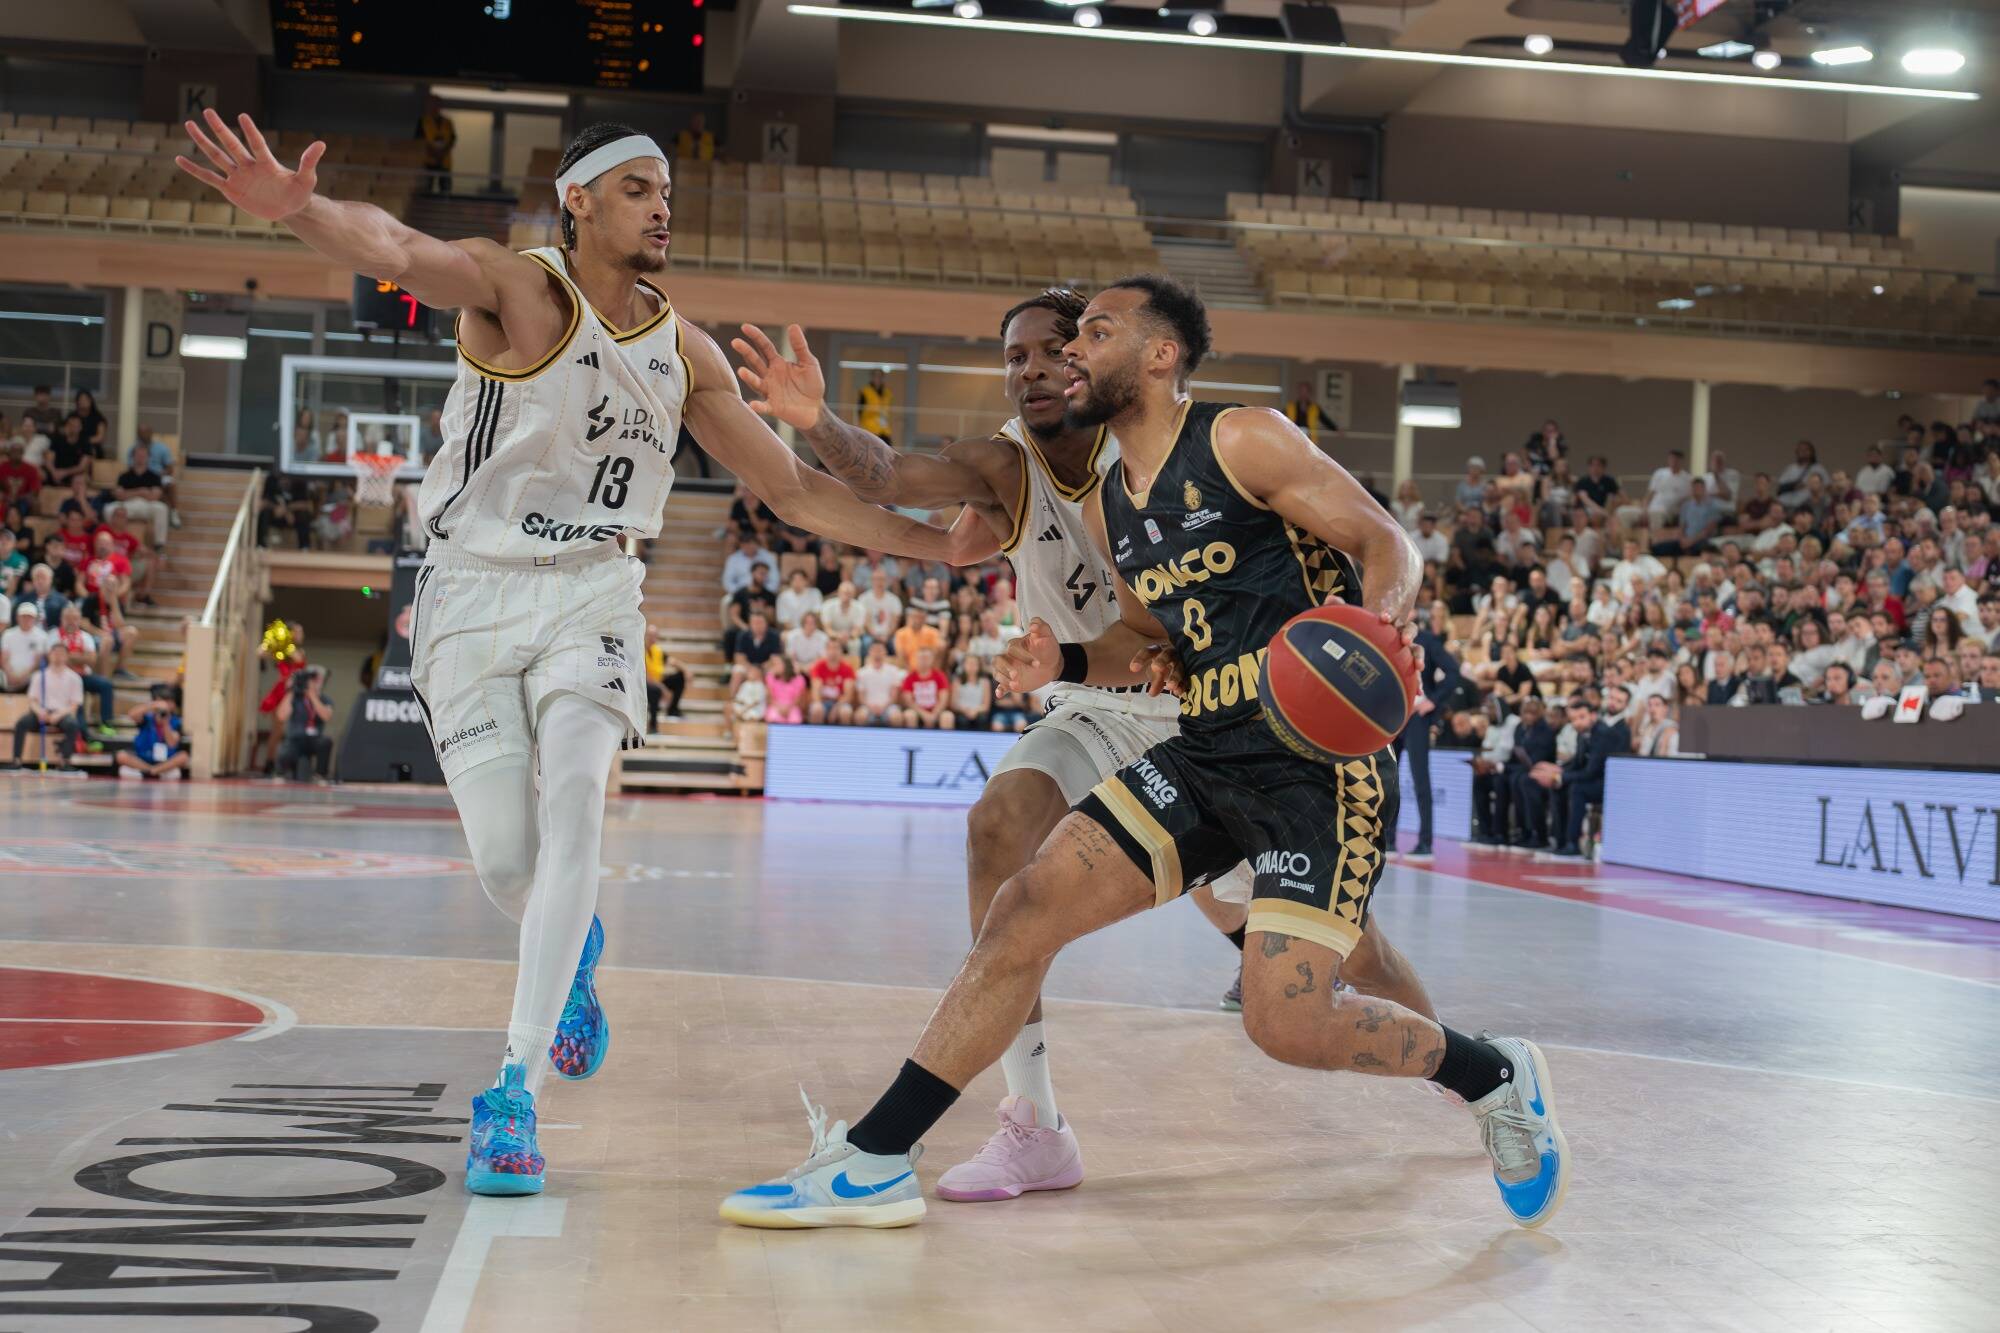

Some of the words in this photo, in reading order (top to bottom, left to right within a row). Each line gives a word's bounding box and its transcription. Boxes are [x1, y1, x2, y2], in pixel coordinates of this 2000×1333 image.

[187, 87, 206, 113] K
[769, 127, 789, 152] K
[1304, 161, 1325, 187] K
[1848, 201, 1865, 226] K
[399, 293, 417, 328] 7
[146, 321, 174, 358] D
[1326, 372, 1345, 400] E
[618, 429, 667, 454] ASVEL
[587, 454, 635, 510] 13
[1182, 597, 1212, 652] 0
[445, 718, 498, 750] Adéquat
[898, 745, 989, 790] LA
[1142, 784, 1166, 810] .news
[1279, 877, 1315, 895] SPALDING
